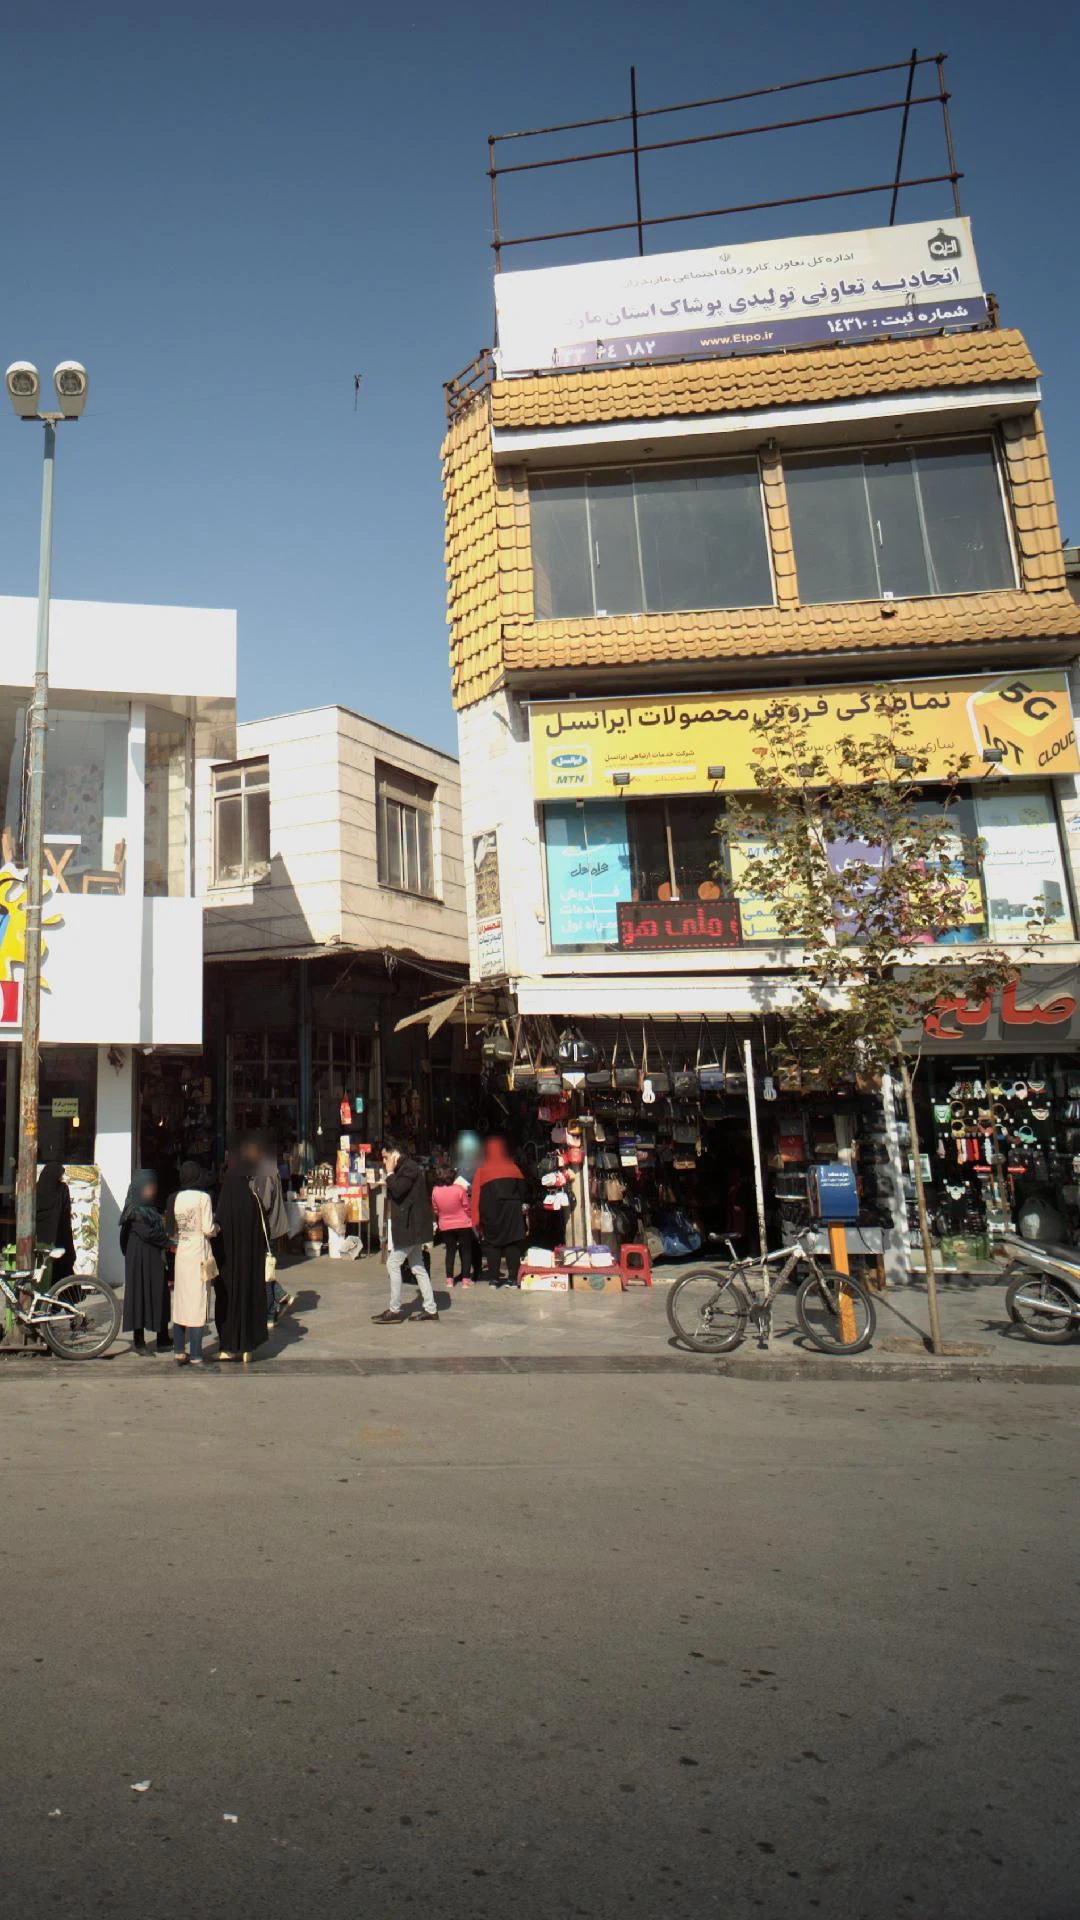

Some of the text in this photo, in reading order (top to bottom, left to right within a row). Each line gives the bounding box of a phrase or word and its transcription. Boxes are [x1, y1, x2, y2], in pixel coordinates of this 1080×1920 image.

[871, 266, 960, 294] اتحادیه
[728, 287, 795, 314] تولیدی
[801, 278, 866, 306] تعاونی
[605, 303, 656, 326] استان
[660, 297, 722, 317] پوشاک
[918, 305, 969, 322] شماره
[700, 331, 774, 347] www.Etpo.ir
[545, 690, 951, 738] نمایندگی فروش محصولات ایرانسل
[556, 775, 584, 784] MTN
[560, 885, 620, 902] فروش
